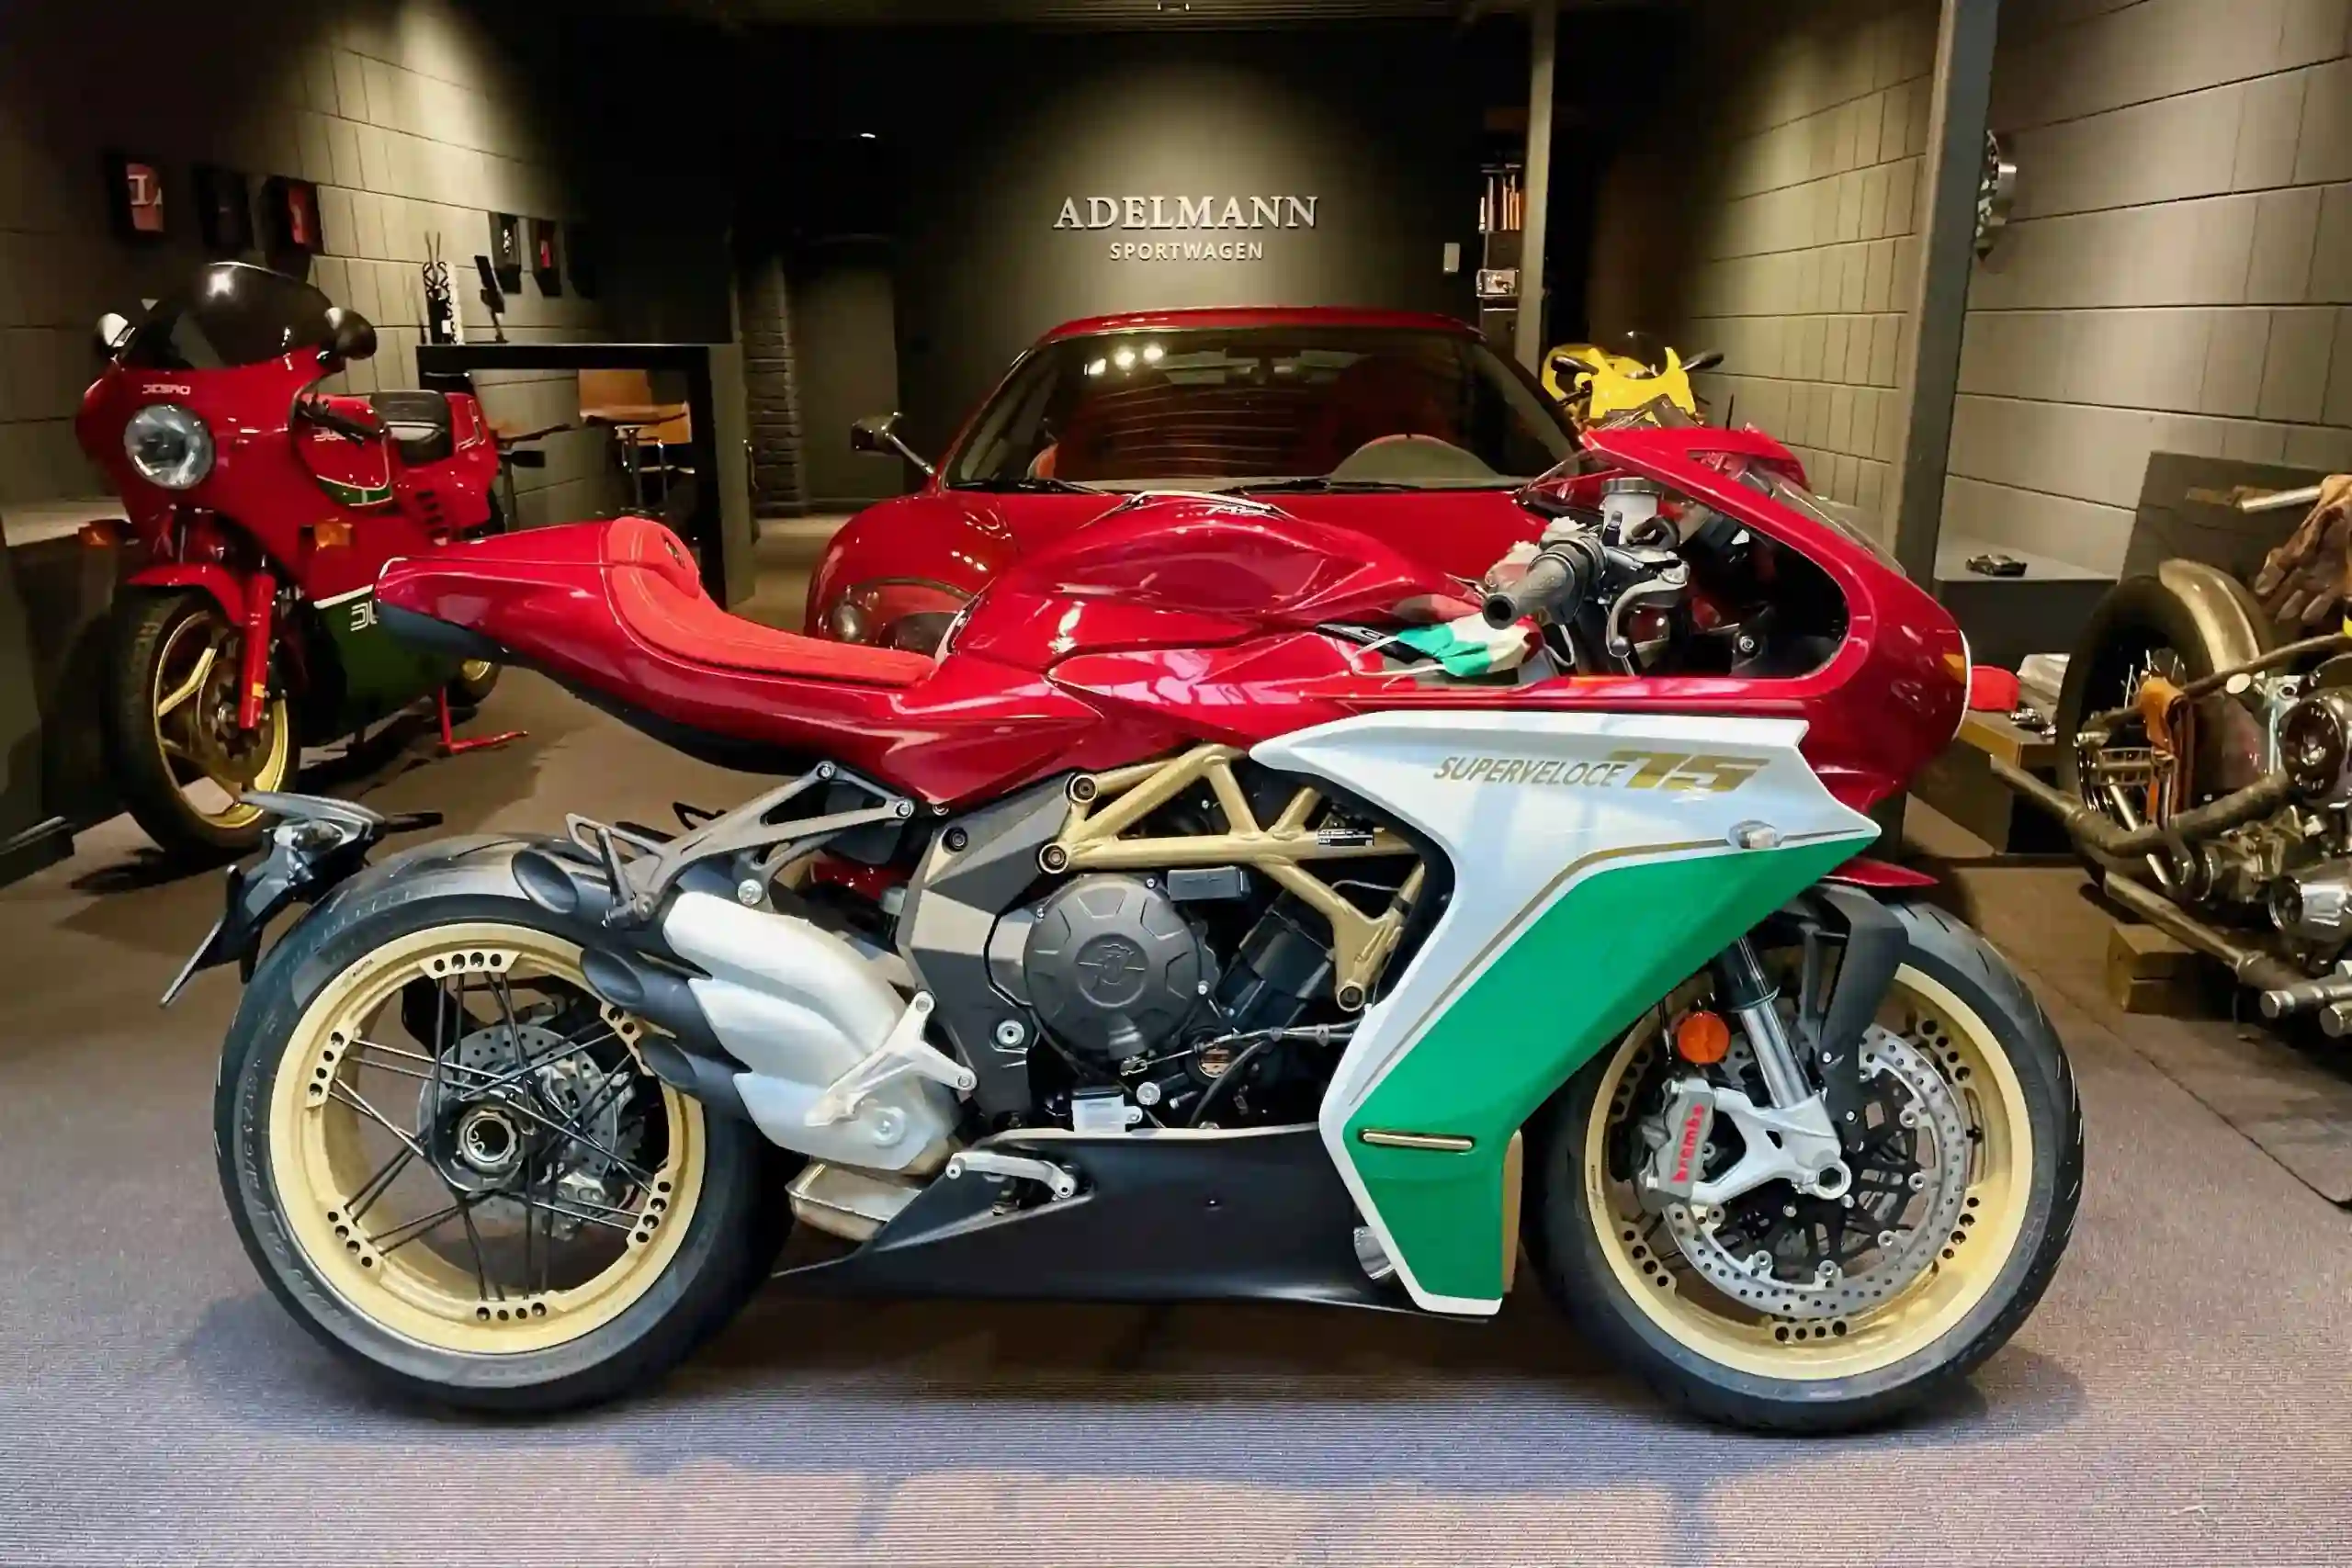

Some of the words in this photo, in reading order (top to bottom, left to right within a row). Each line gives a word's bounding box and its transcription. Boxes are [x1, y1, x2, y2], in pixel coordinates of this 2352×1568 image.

[1052, 196, 1318, 229] ADELMANN
[1109, 242, 1264, 260] SPORTWAGEN
[1434, 756, 1628, 787] SUPERVELOCE
[1670, 1102, 1706, 1184] brembo
